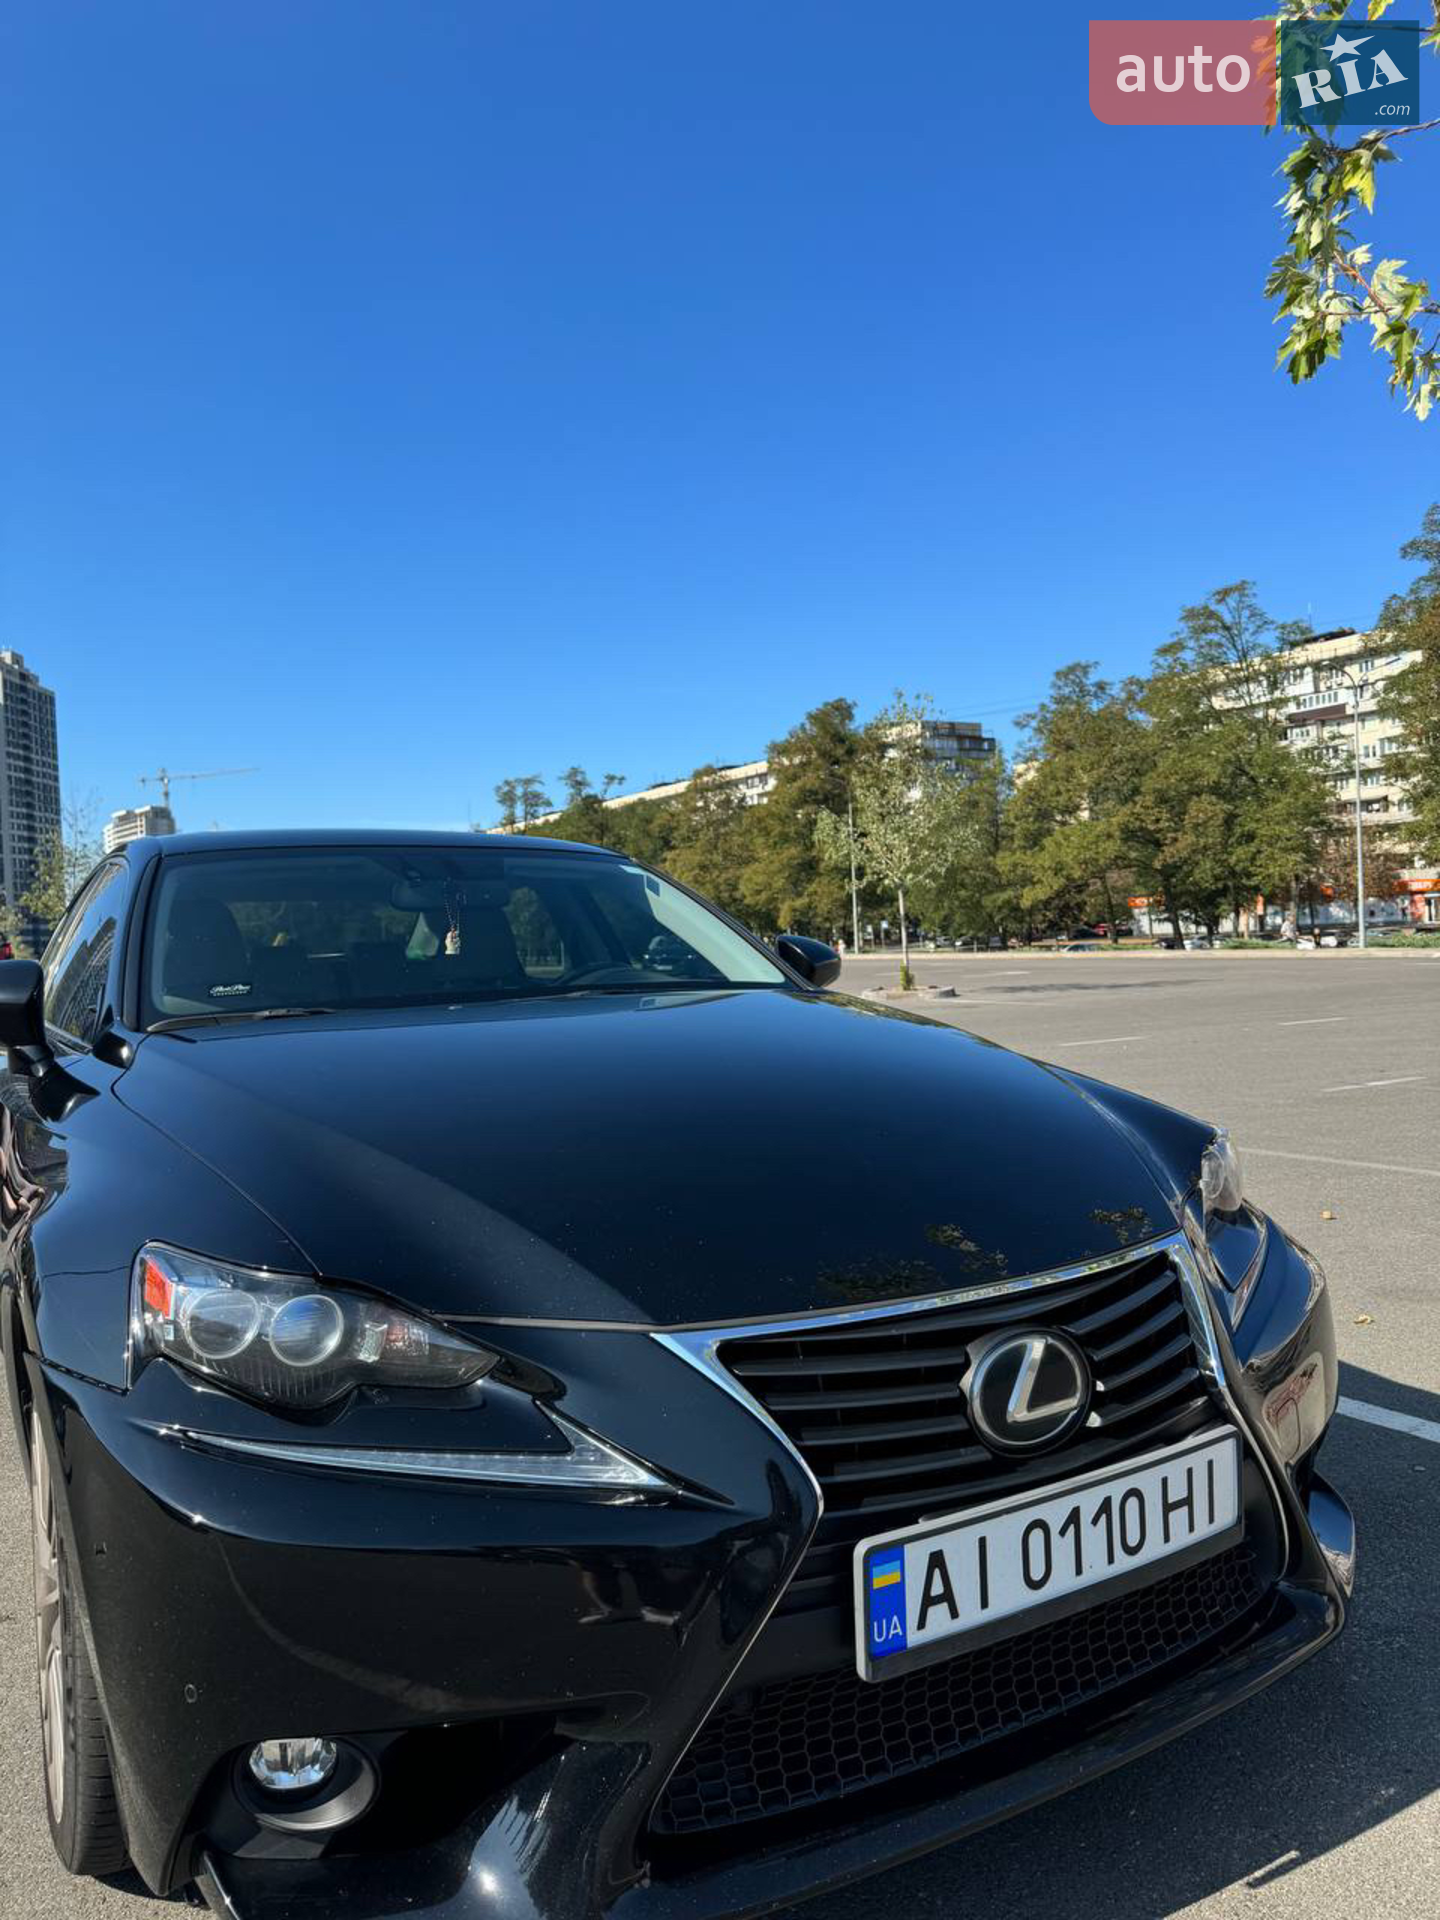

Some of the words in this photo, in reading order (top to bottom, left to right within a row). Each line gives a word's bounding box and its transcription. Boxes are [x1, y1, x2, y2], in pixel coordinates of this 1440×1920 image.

[916, 1535, 989, 1631] AI
[1021, 1487, 1146, 1591] 0110
[1161, 1459, 1215, 1545] HI
[873, 1615, 903, 1643] UA
